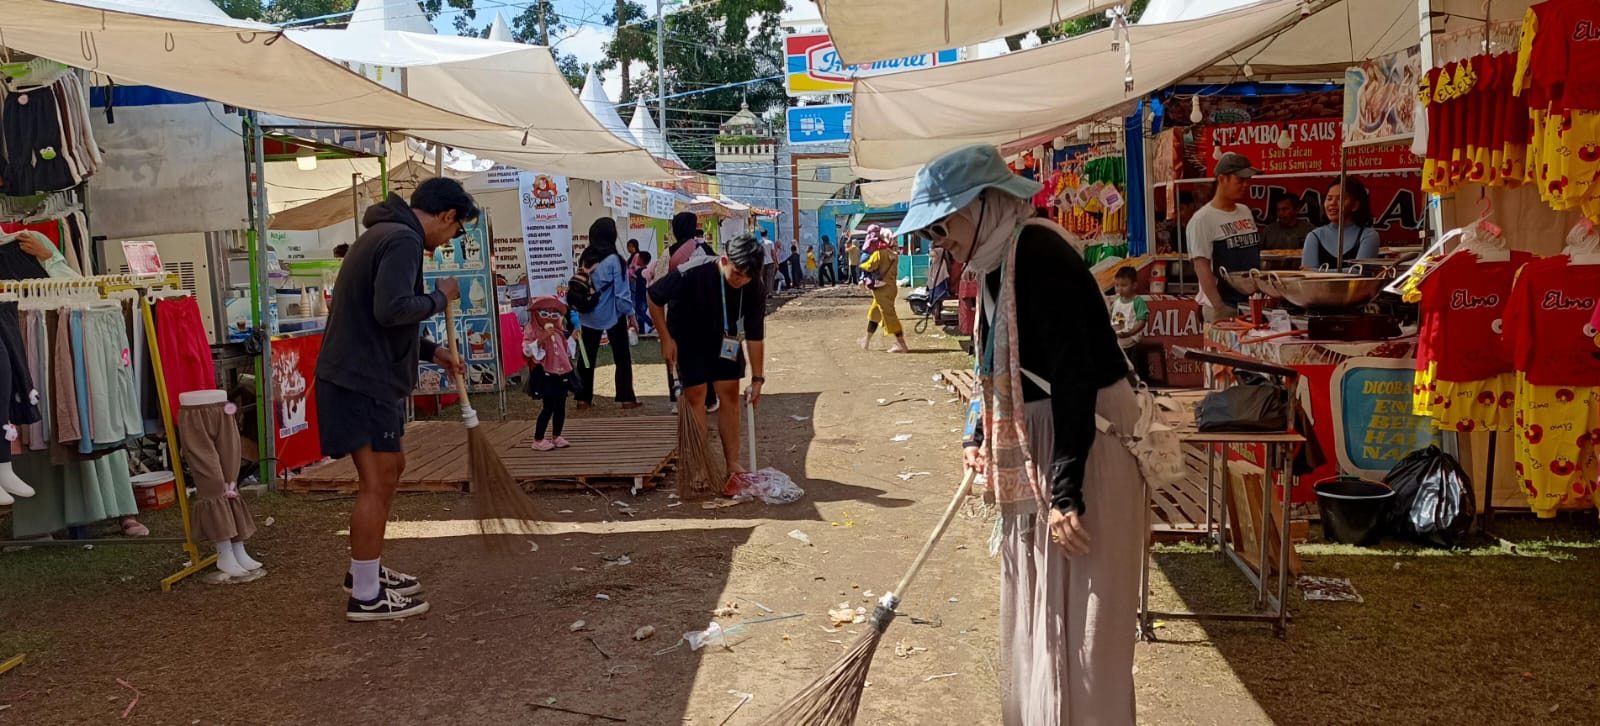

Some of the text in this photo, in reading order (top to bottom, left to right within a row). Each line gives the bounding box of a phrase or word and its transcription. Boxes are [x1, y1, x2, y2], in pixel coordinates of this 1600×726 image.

[1212, 124, 1298, 146] STEAMBOT
[1300, 121, 1336, 142] SAUS
[1268, 148, 1286, 159] Saus
[1269, 160, 1287, 171] Saus
[1338, 157, 1357, 168] Sus
[1358, 155, 1382, 167] Korea
[1450, 288, 1500, 311] Elmo
[1541, 288, 1596, 311] Elmo
[1362, 380, 1414, 395] DICOBA
